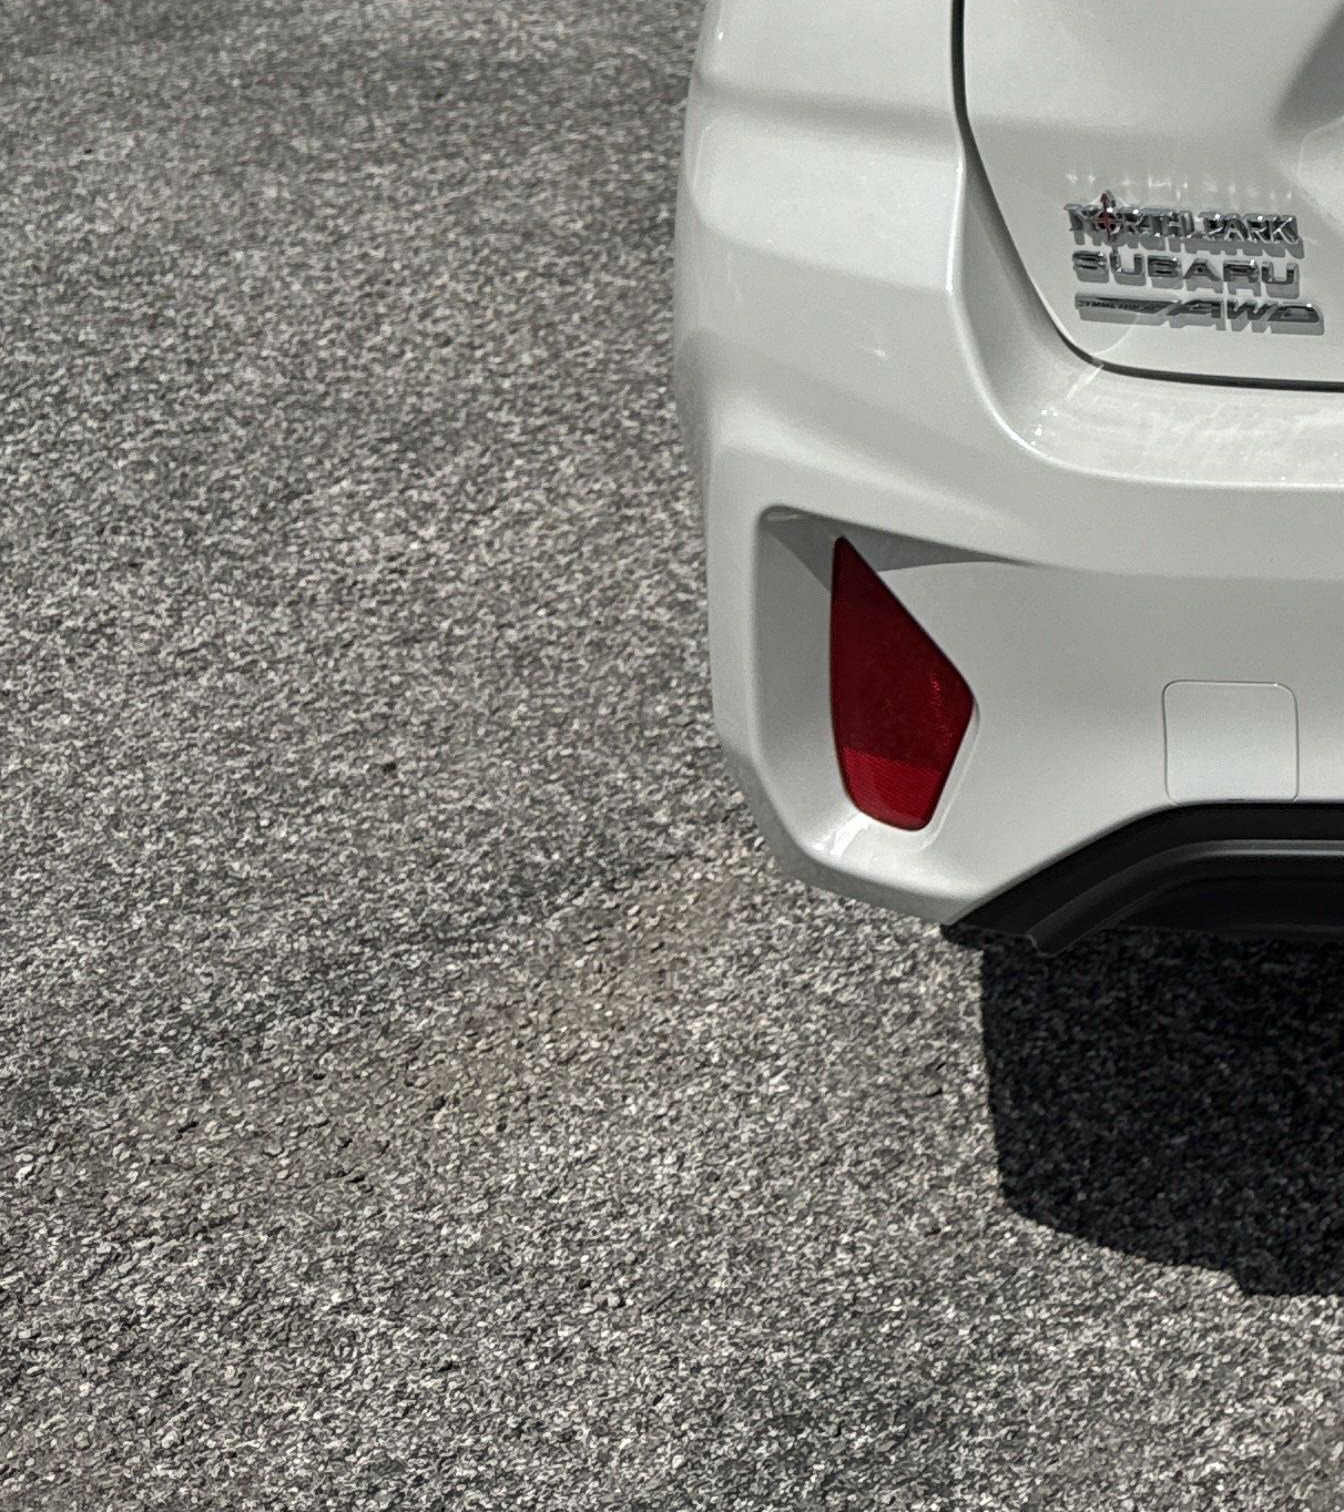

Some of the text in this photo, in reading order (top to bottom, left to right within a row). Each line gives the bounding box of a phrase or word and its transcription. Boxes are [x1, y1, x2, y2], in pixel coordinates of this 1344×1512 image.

[1065, 201, 1301, 245] NORTH PARK
[1073, 250, 1300, 286] SUBARU
[1166, 297, 1321, 323] AWD
